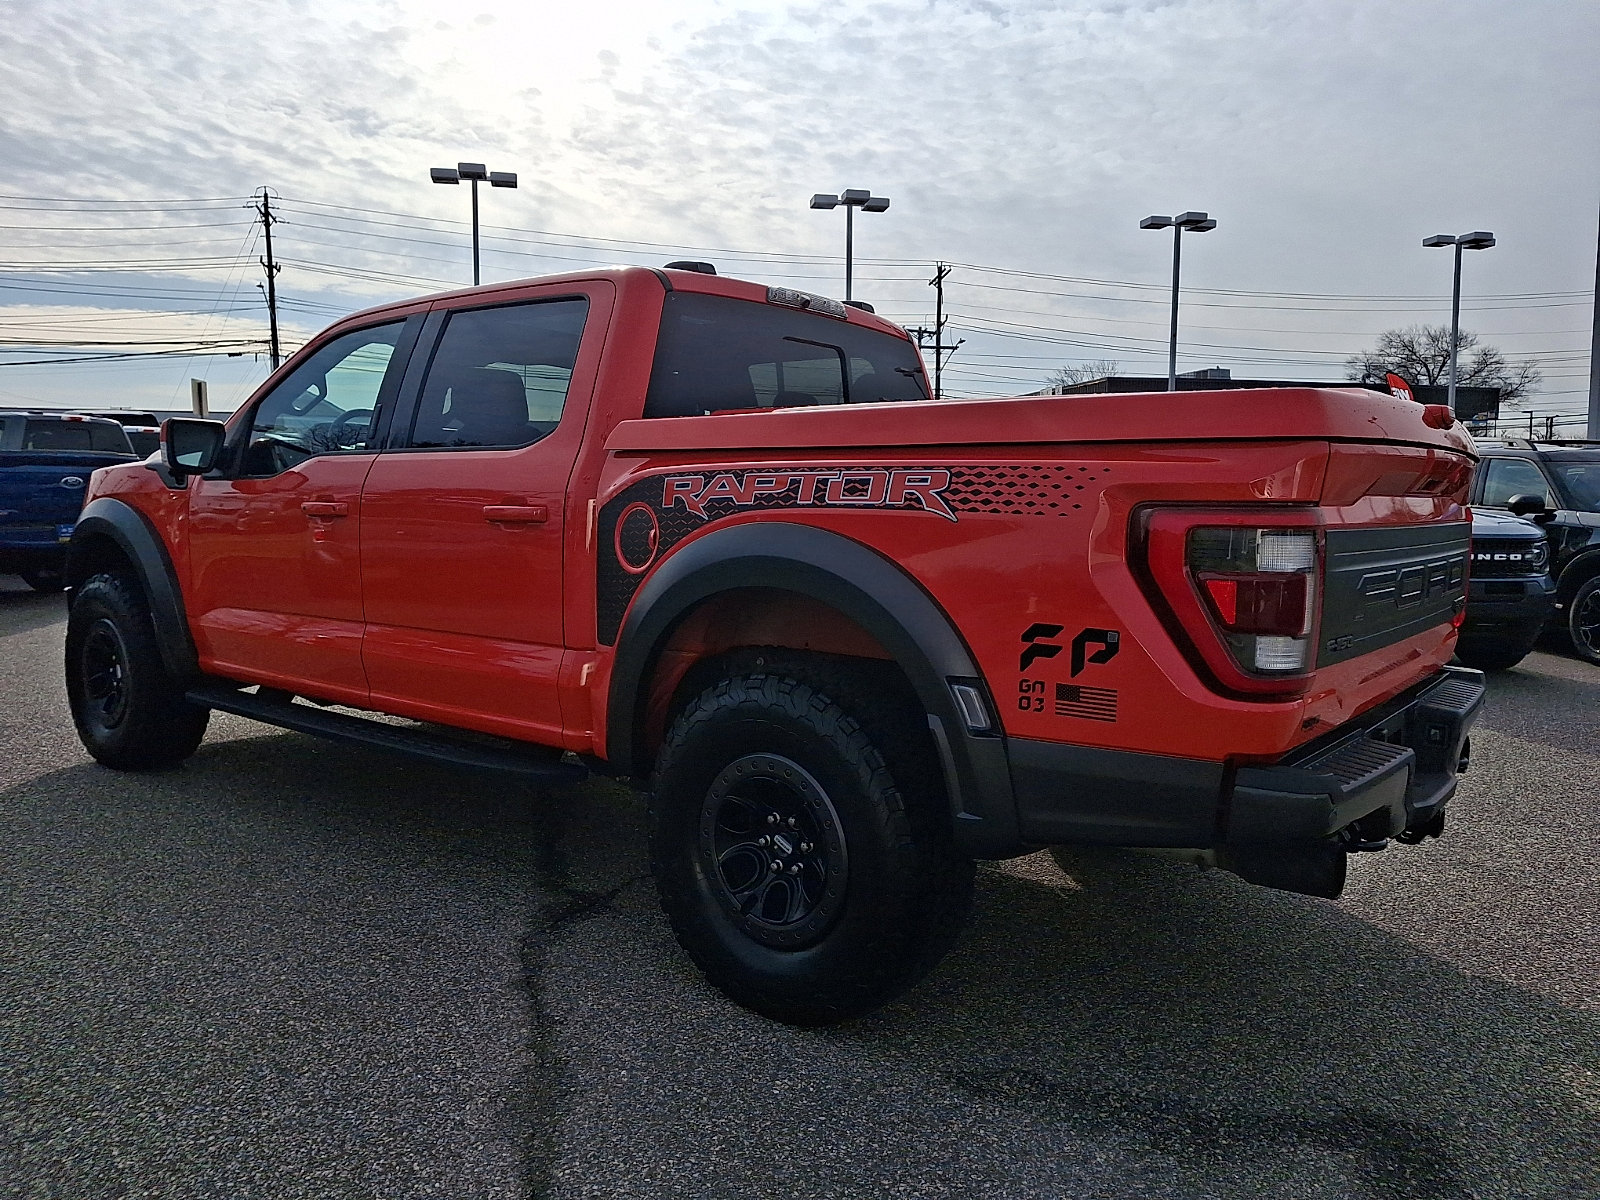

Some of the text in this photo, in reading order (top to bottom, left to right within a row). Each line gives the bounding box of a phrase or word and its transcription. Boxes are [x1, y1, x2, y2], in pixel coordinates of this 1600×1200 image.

[662, 469, 958, 523] RAPTOR
[1470, 553, 1523, 561] NCO
[1353, 555, 1464, 620] FORD
[1019, 622, 1121, 678] FP
[1018, 696, 1045, 713] 03
